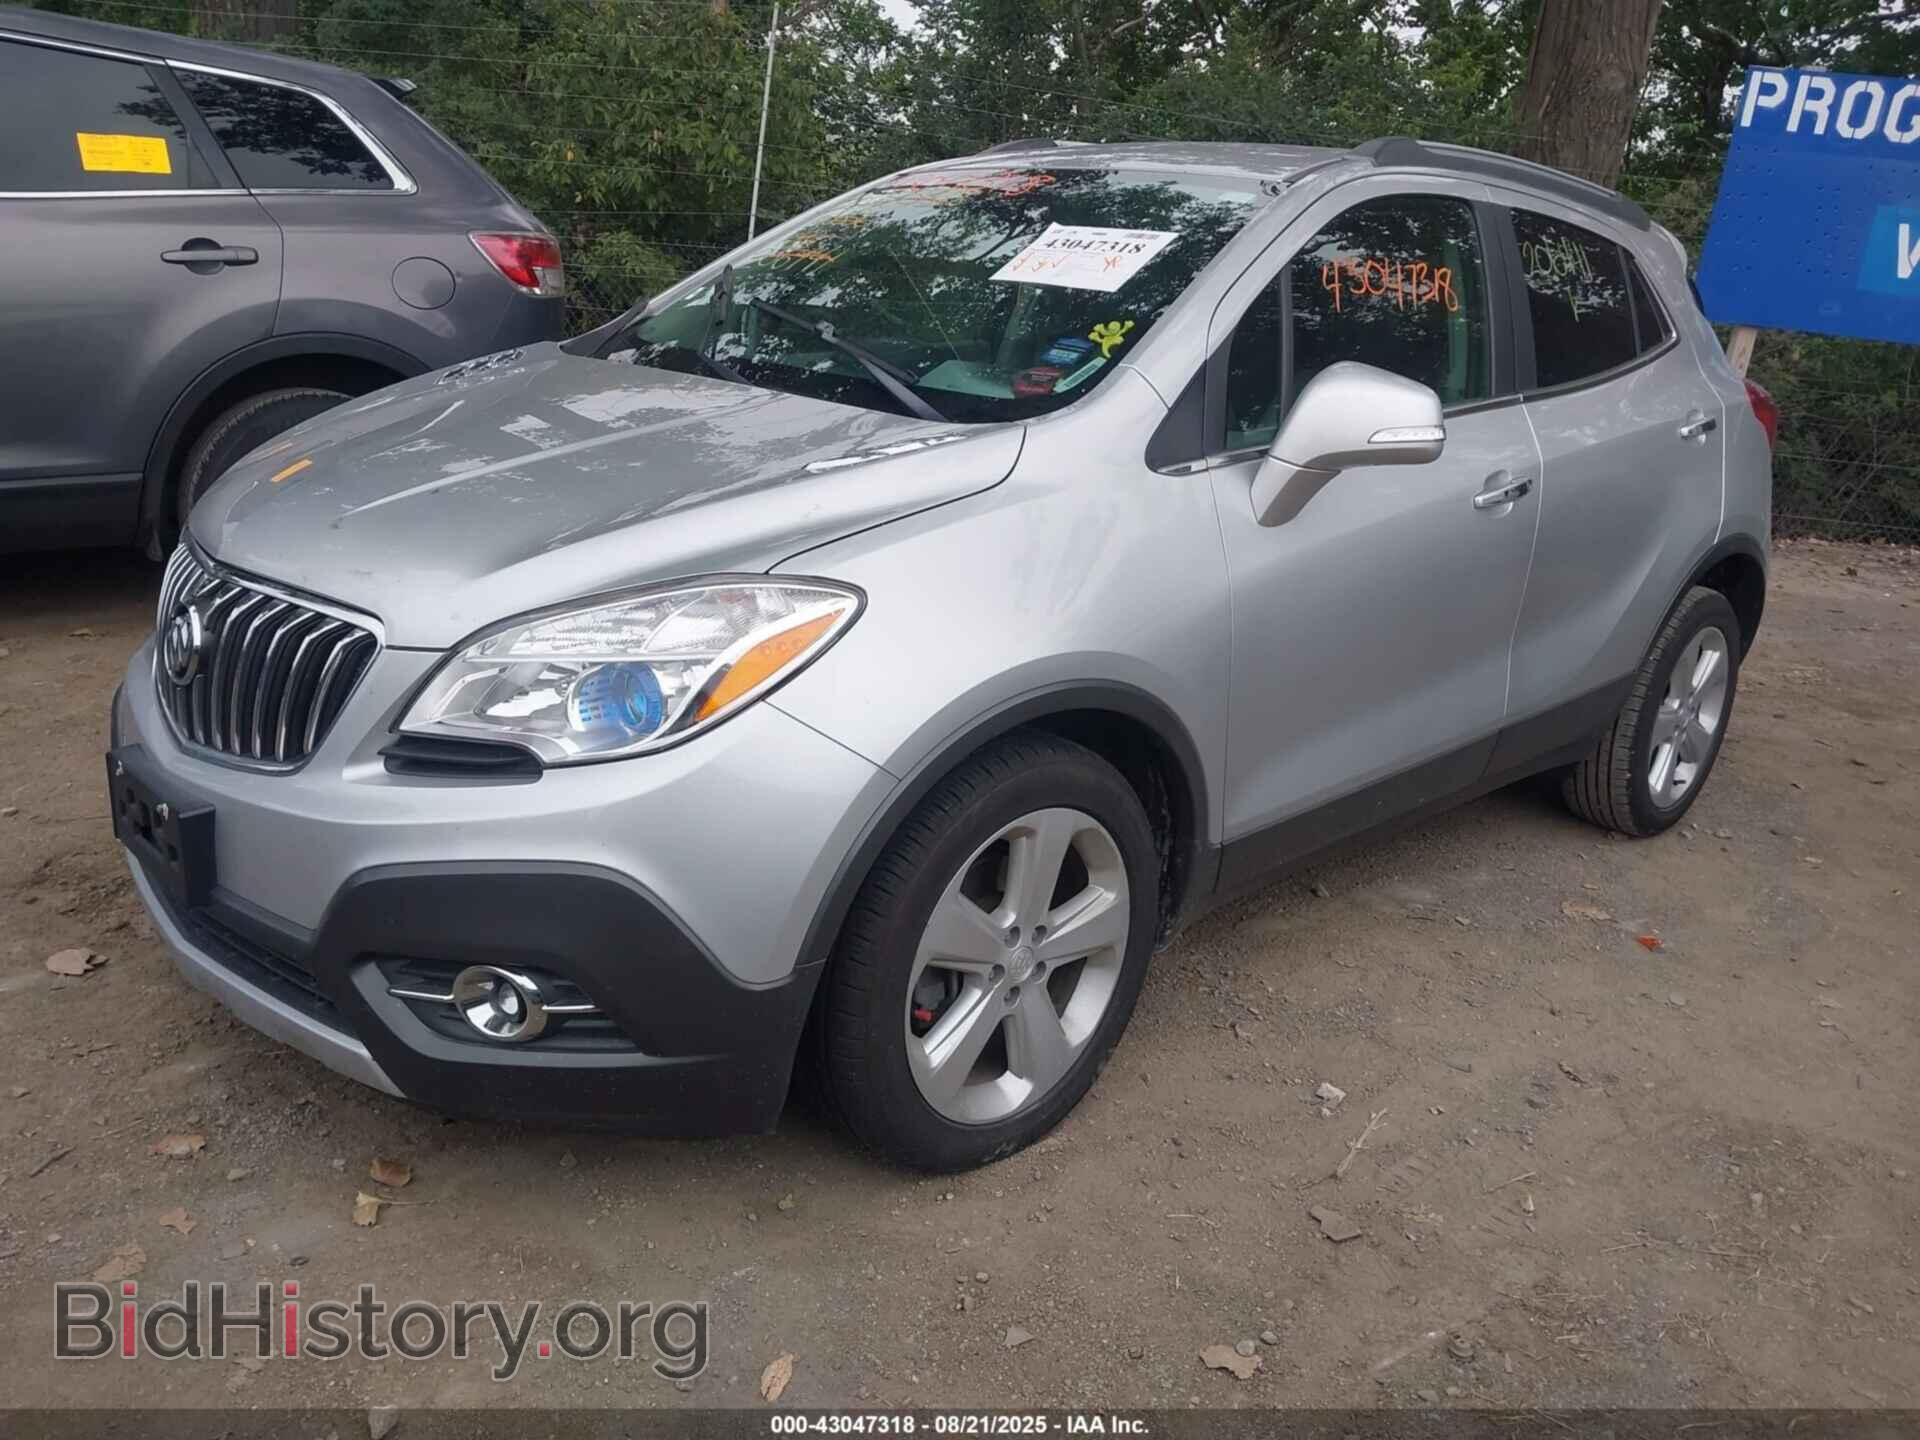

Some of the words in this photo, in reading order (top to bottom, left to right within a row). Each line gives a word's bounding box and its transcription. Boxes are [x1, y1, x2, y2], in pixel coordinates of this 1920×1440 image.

[1740, 71, 1920, 144] PROG
[1044, 238, 1147, 254] 43047318
[1322, 257, 1458, 313] 43047318
